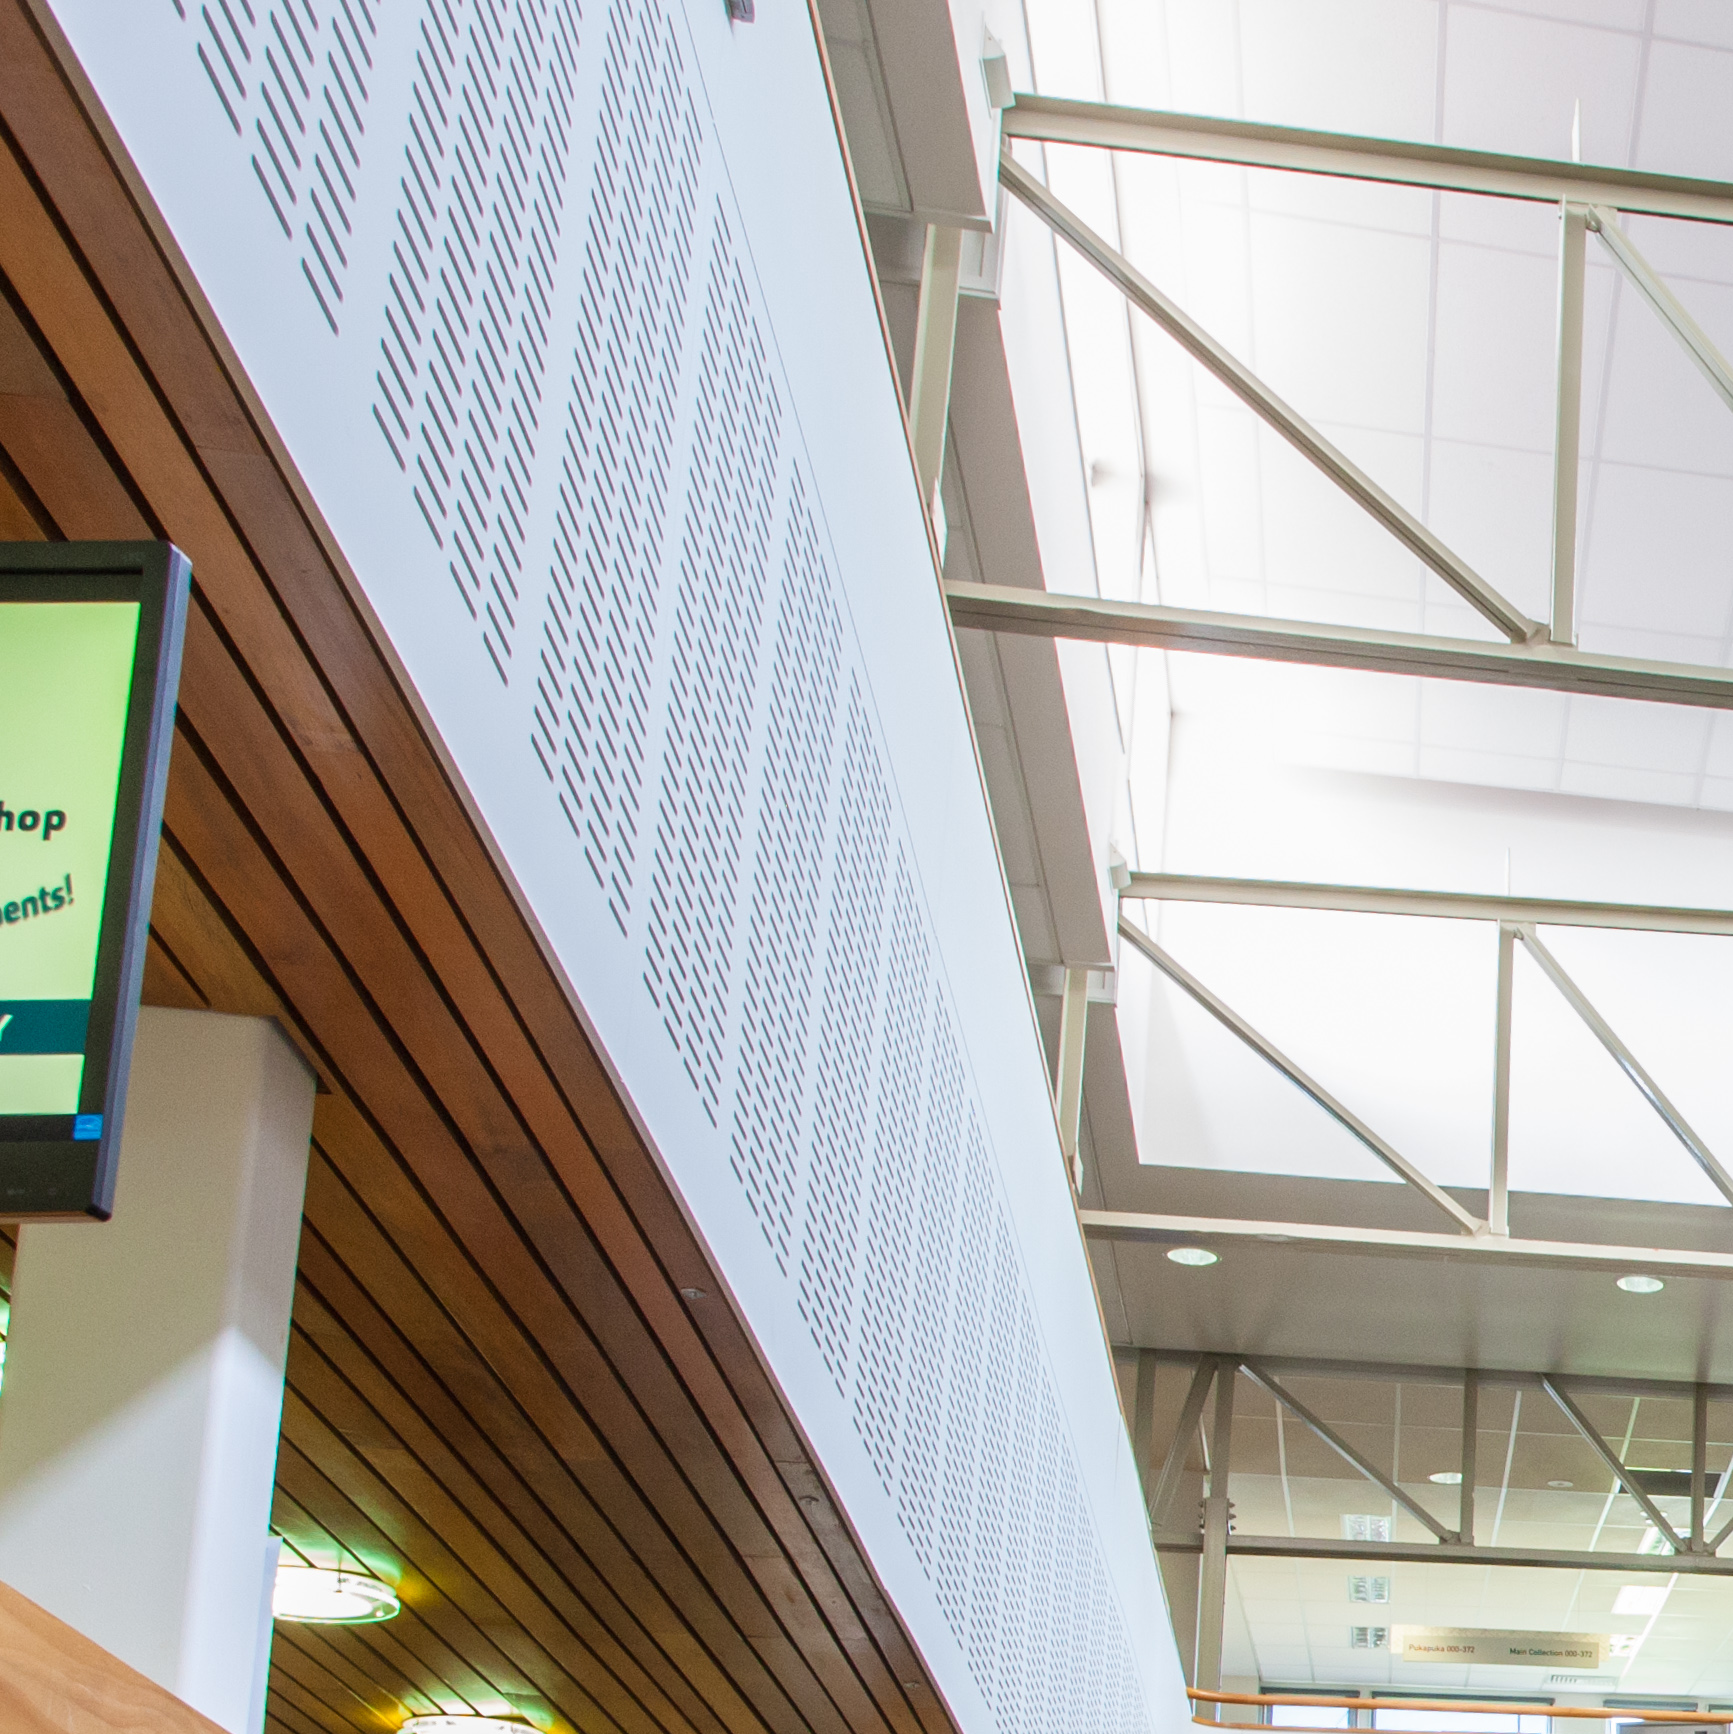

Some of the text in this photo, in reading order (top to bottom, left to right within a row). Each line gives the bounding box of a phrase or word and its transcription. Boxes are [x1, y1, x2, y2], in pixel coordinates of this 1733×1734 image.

[0, 803, 67, 841] hop
[0, 873, 75, 926] ents!
[1408, 1643, 1475, 1654] Pukapuka 000-372
[1509, 1647, 1593, 1658] Main Collection 000-372
